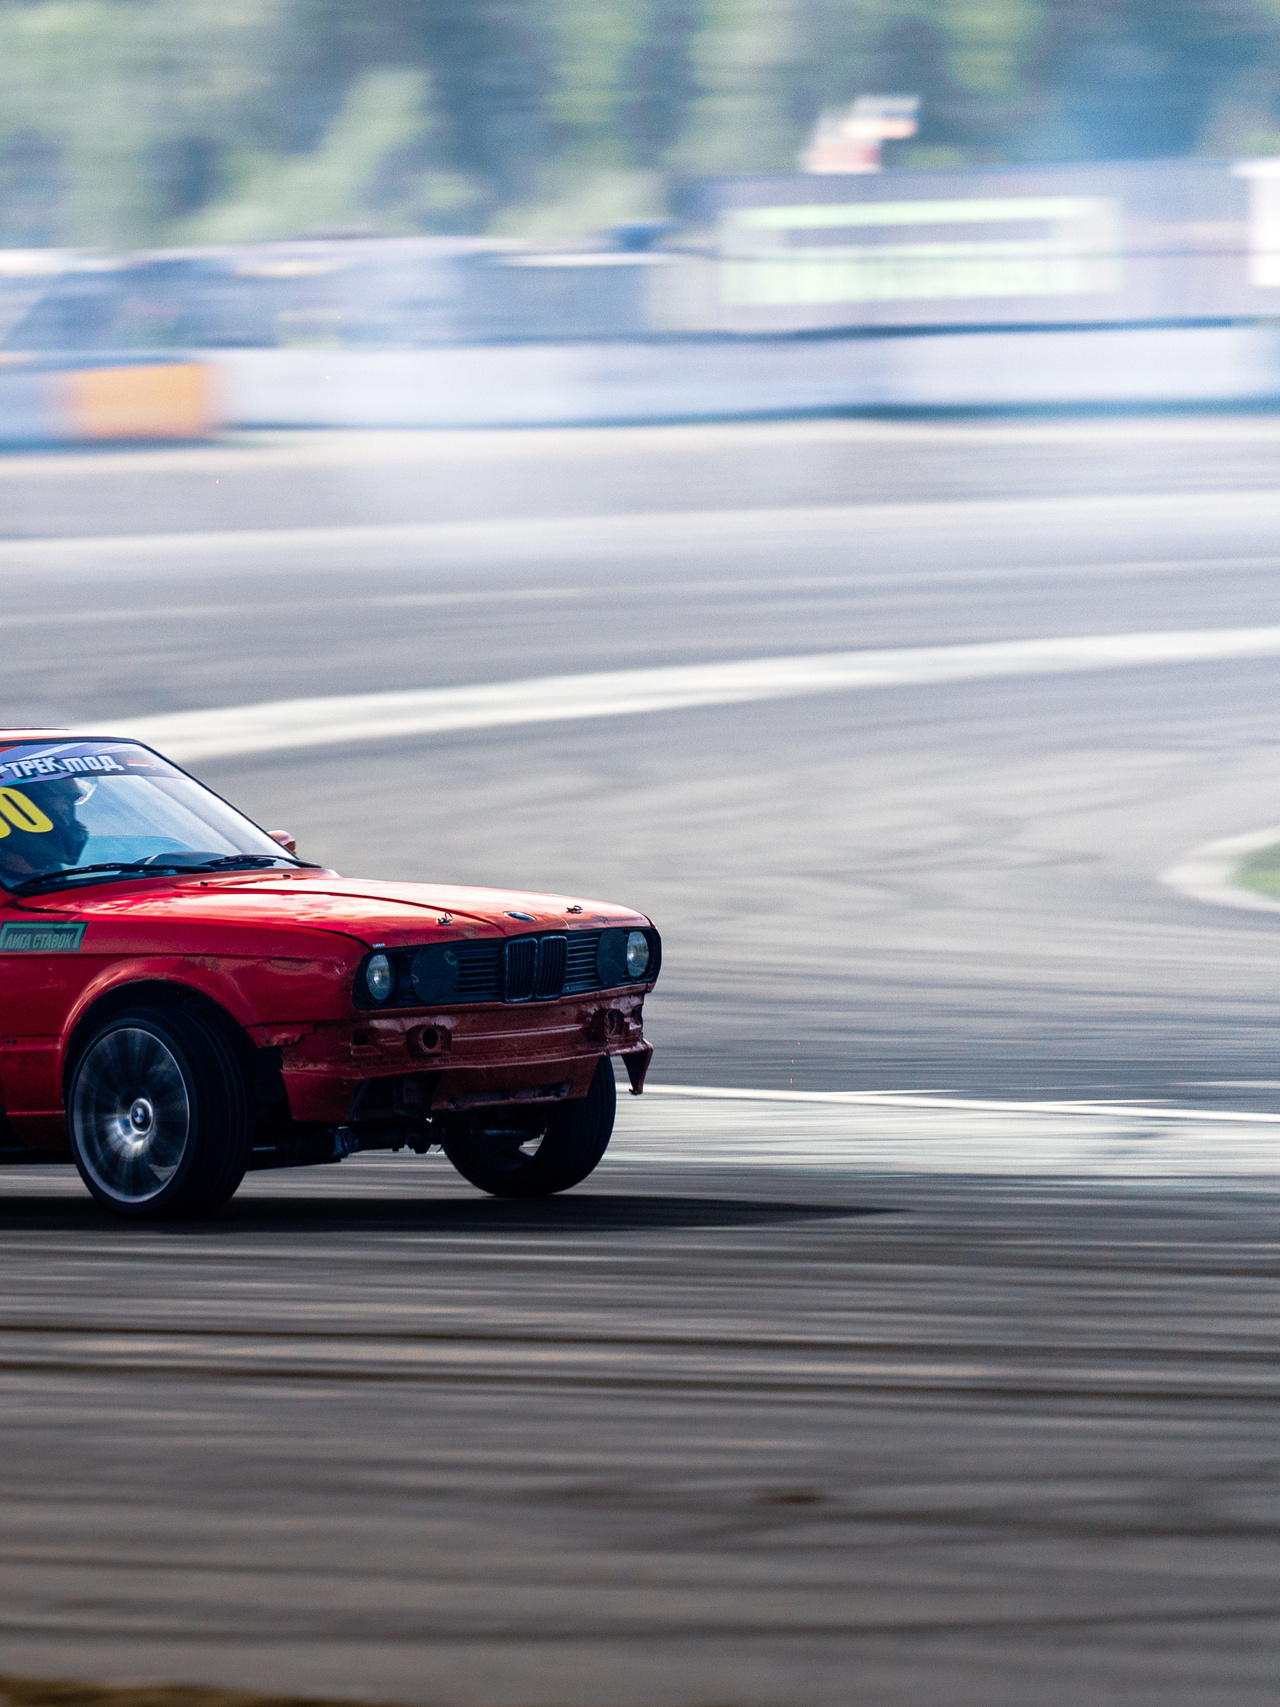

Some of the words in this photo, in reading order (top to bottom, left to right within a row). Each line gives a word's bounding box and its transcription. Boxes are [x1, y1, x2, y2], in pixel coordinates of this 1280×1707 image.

[6, 757, 66, 778] ТРЕК
[5, 933, 31, 948] ЛИГА
[32, 933, 74, 948] СТАВОК
